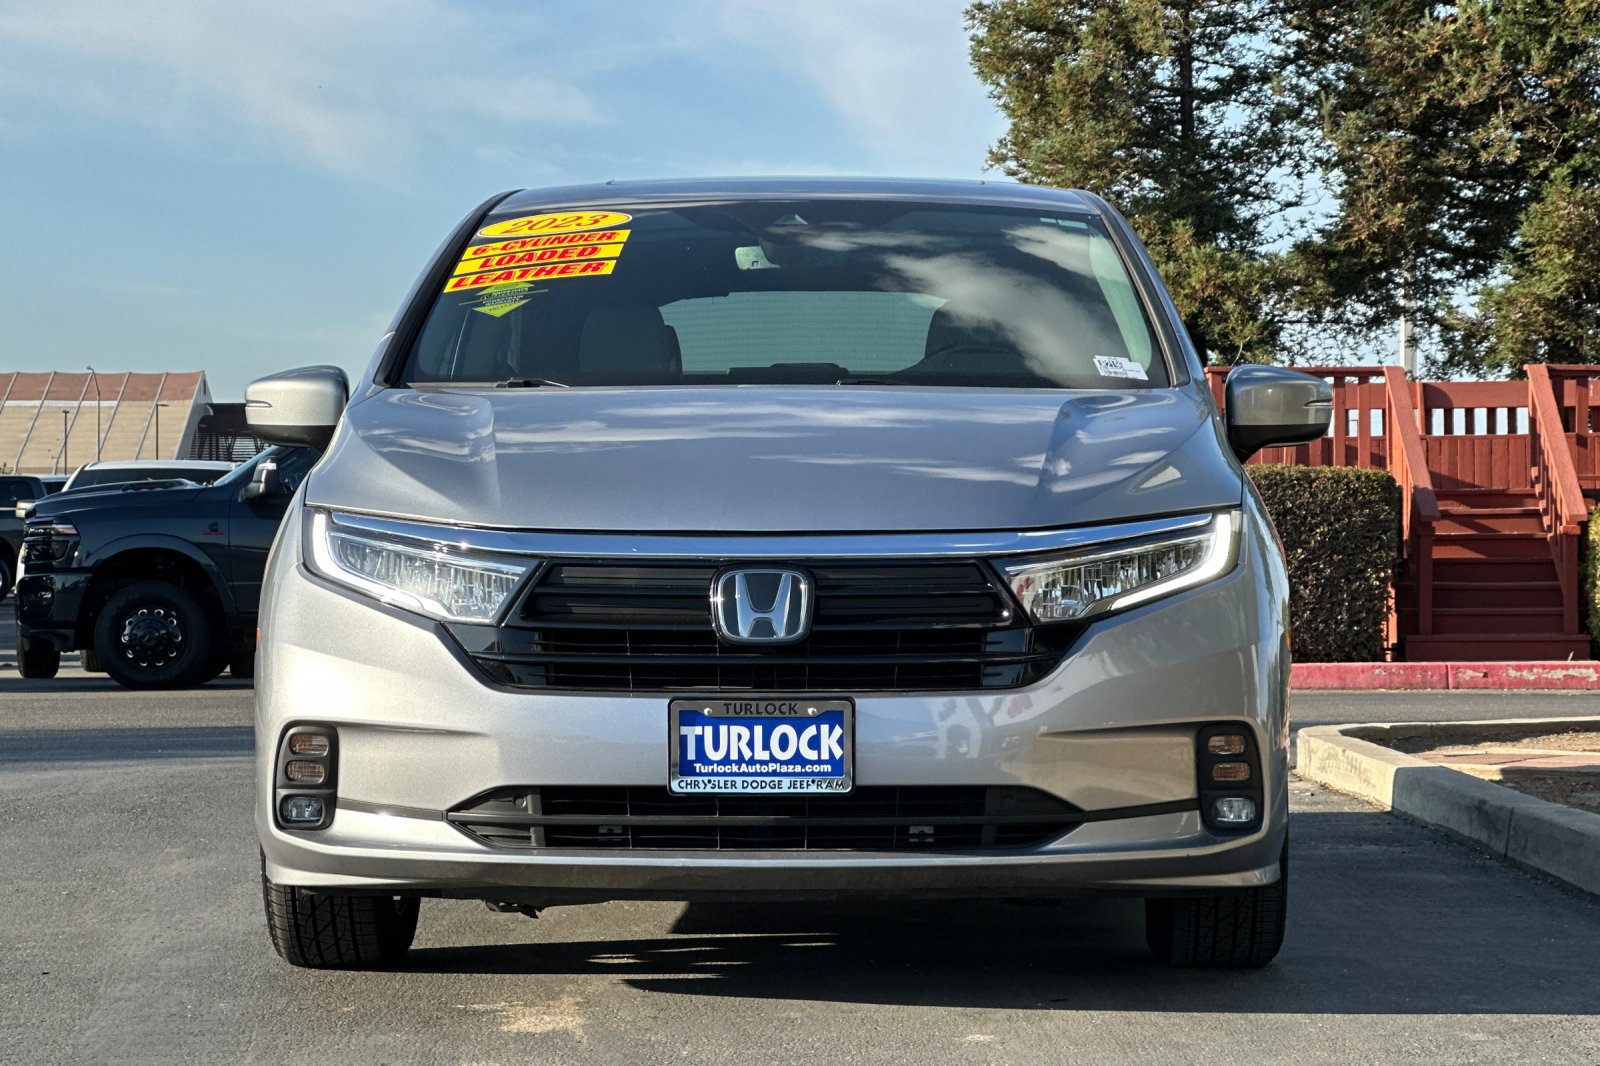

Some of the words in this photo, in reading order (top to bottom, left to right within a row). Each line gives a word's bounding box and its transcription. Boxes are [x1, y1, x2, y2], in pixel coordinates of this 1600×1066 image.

[501, 214, 609, 234] 2023
[471, 231, 620, 256] 6-CYLINDER
[478, 246, 600, 270] LOADED
[451, 261, 609, 290] LEATHER
[723, 703, 798, 715] TURLOCK
[679, 724, 844, 761] TURLOCK
[693, 763, 832, 773] TurlockAutoPlaza.com
[741, 779, 783, 790] DODGE
[816, 779, 845, 790] RAM
